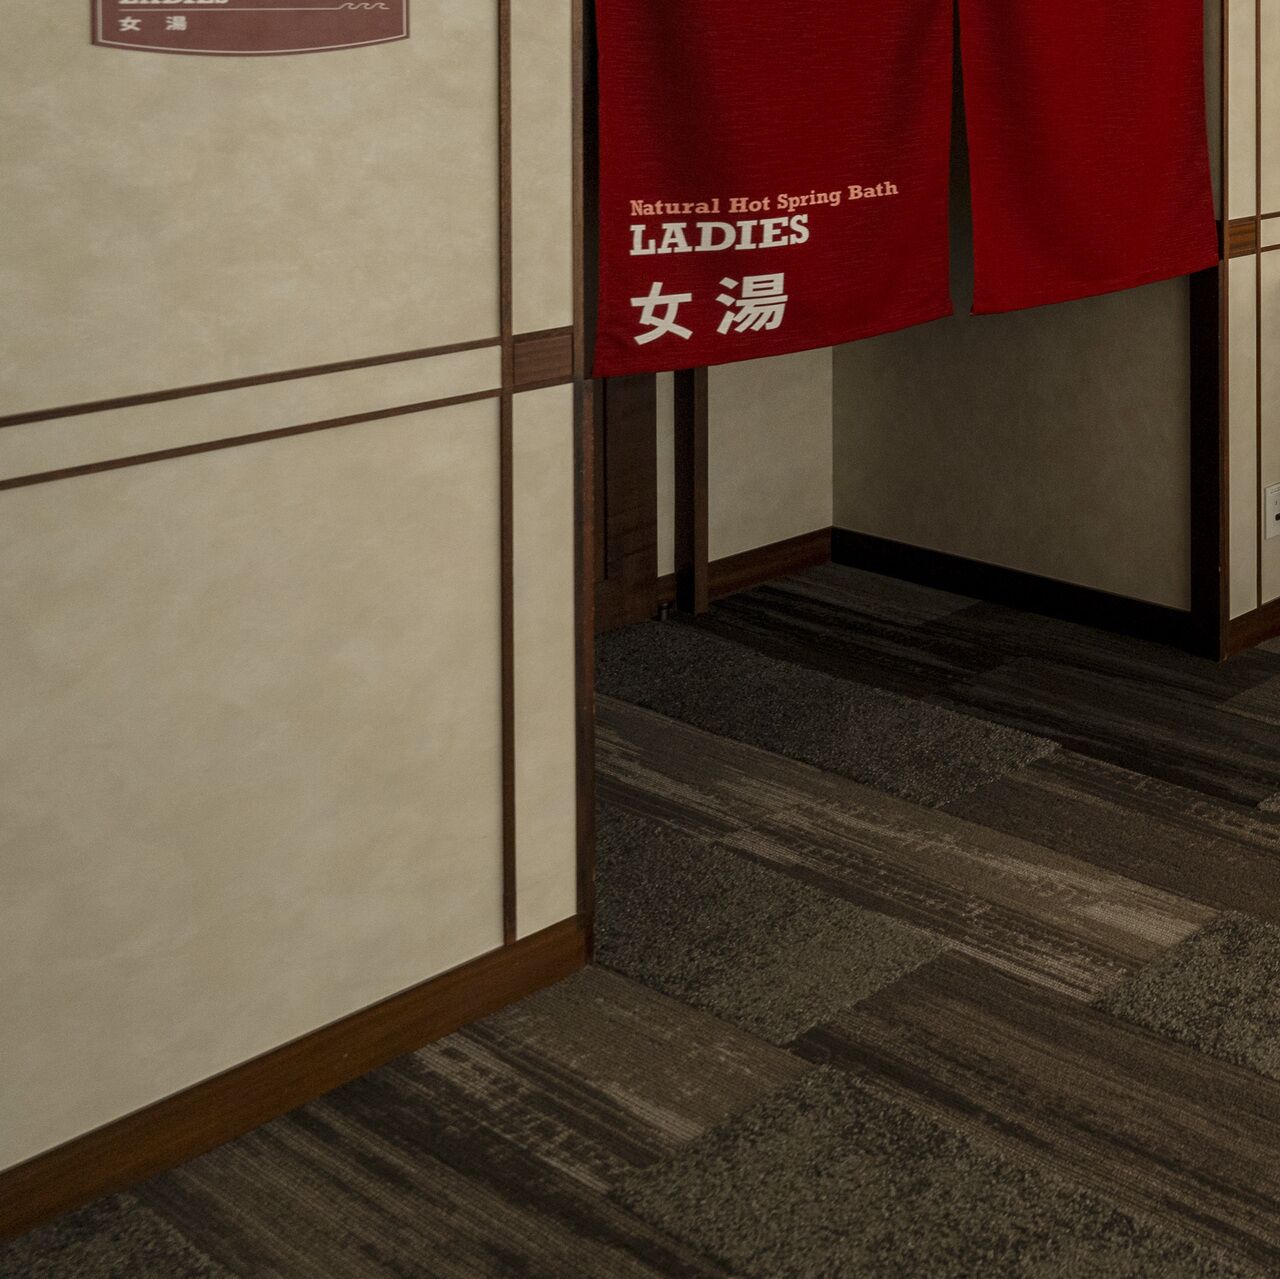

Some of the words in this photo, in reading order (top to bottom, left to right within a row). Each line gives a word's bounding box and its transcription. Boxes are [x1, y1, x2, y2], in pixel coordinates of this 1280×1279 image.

[629, 198, 721, 217] Natural
[728, 196, 771, 213] Hot
[776, 189, 843, 213] Spring
[847, 180, 900, 201] Bath
[629, 213, 811, 257] LADIES
